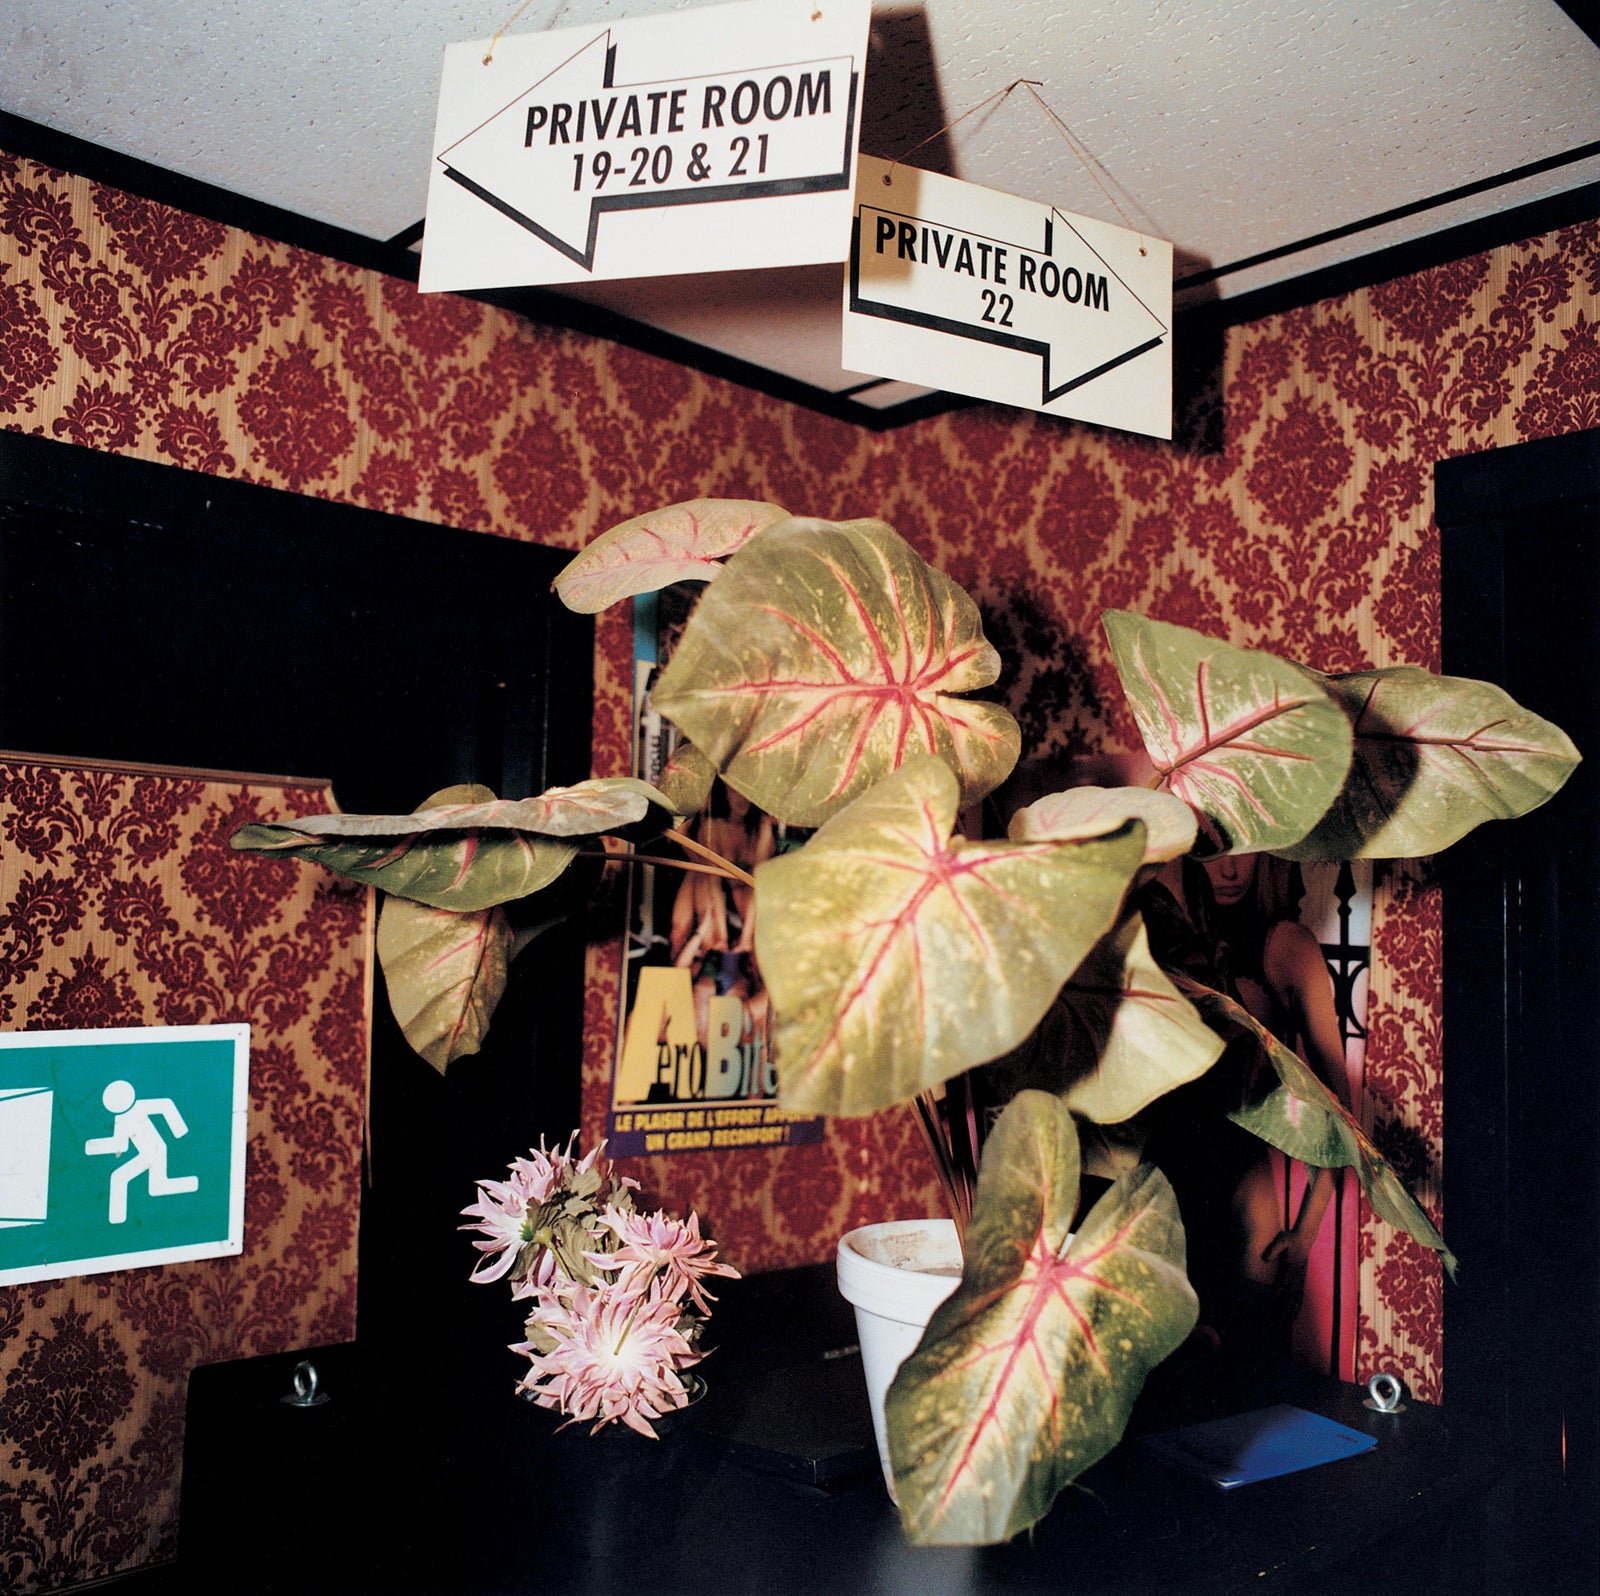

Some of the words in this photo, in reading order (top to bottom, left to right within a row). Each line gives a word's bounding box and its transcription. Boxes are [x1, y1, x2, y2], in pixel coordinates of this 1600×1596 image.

[524, 88, 688, 148] PRIVATE
[701, 70, 832, 129] ROOM
[572, 144, 673, 191] 19-20
[686, 142, 712, 181] &
[728, 134, 769, 177] 21
[875, 215, 1007, 285] PRIVATE
[1019, 253, 1110, 312] ROOM
[980, 288, 1014, 328] 22
[615, 1113, 632, 1132] LE
[633, 1111, 685, 1131] PLAISIR
[687, 1110, 705, 1129] DE
[646, 1133, 666, 1151] UN
[666, 1129, 712, 1150] GRAND
